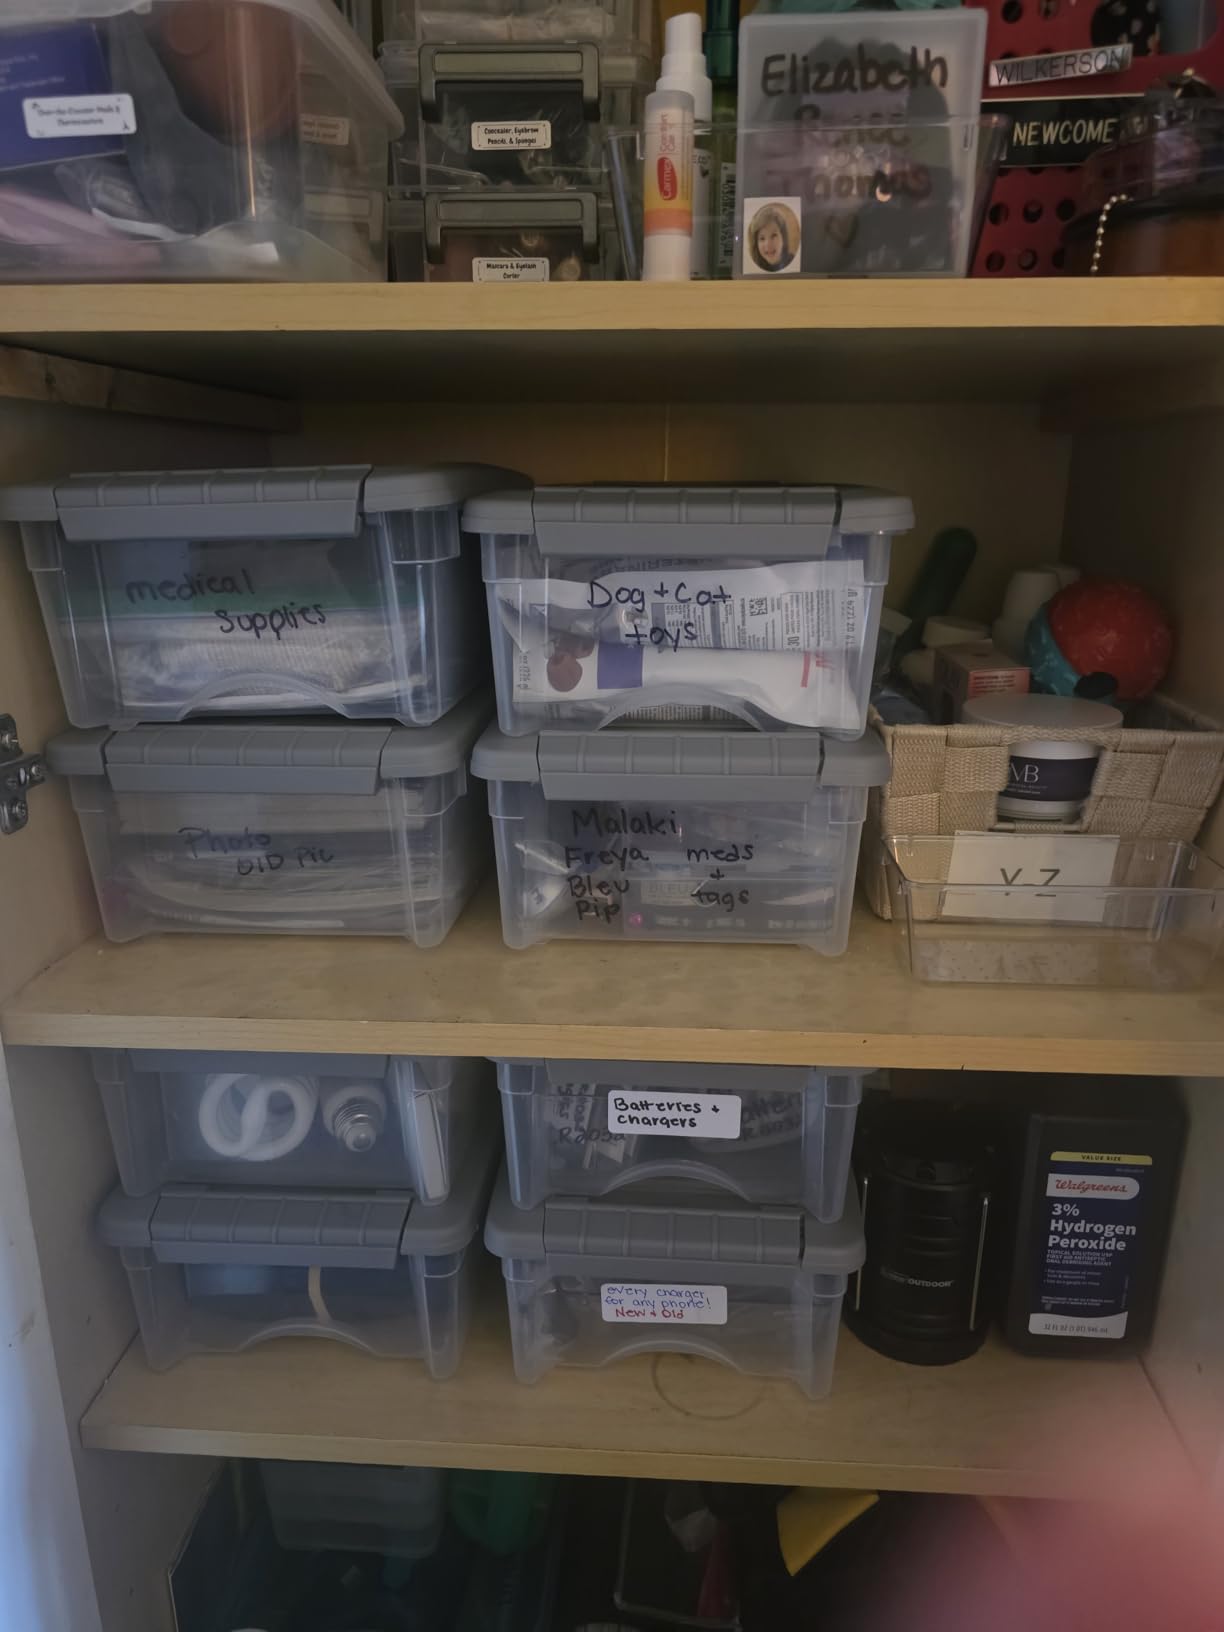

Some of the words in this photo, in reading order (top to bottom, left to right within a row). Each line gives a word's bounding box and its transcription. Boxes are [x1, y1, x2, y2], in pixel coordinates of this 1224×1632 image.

[762, 43, 947, 96] Elizabeth
[996, 48, 1126, 83] WILKERSON
[509, 137, 514, 145] &
[1012, 117, 1120, 147] NEWCOME
[125, 568, 255, 604] medical
[587, 581, 646, 612] Dog
[675, 582, 732, 607] Cat
[624, 624, 698, 651] toys
[570, 808, 679, 837] Malaki
[564, 846, 649, 872] Freya
[576, 901, 621, 924] Pip
[613, 1098, 702, 1114] Batteries
[617, 1114, 697, 1129] chargers
[1055, 1179, 1127, 1194] Walgreens
[1051, 1203, 1080, 1217] 3%
[1050, 1219, 1137, 1237] Hydrogen
[1048, 1234, 1127, 1251] Peroxide
[607, 1286, 647, 1298] every
[656, 1288, 704, 1301] charger
[605, 1296, 624, 1305] for
[632, 1300, 655, 1310] any
[661, 1297, 711, 1310] phone!
[615, 1306, 645, 1318] New
[662, 1309, 684, 1319] Old
